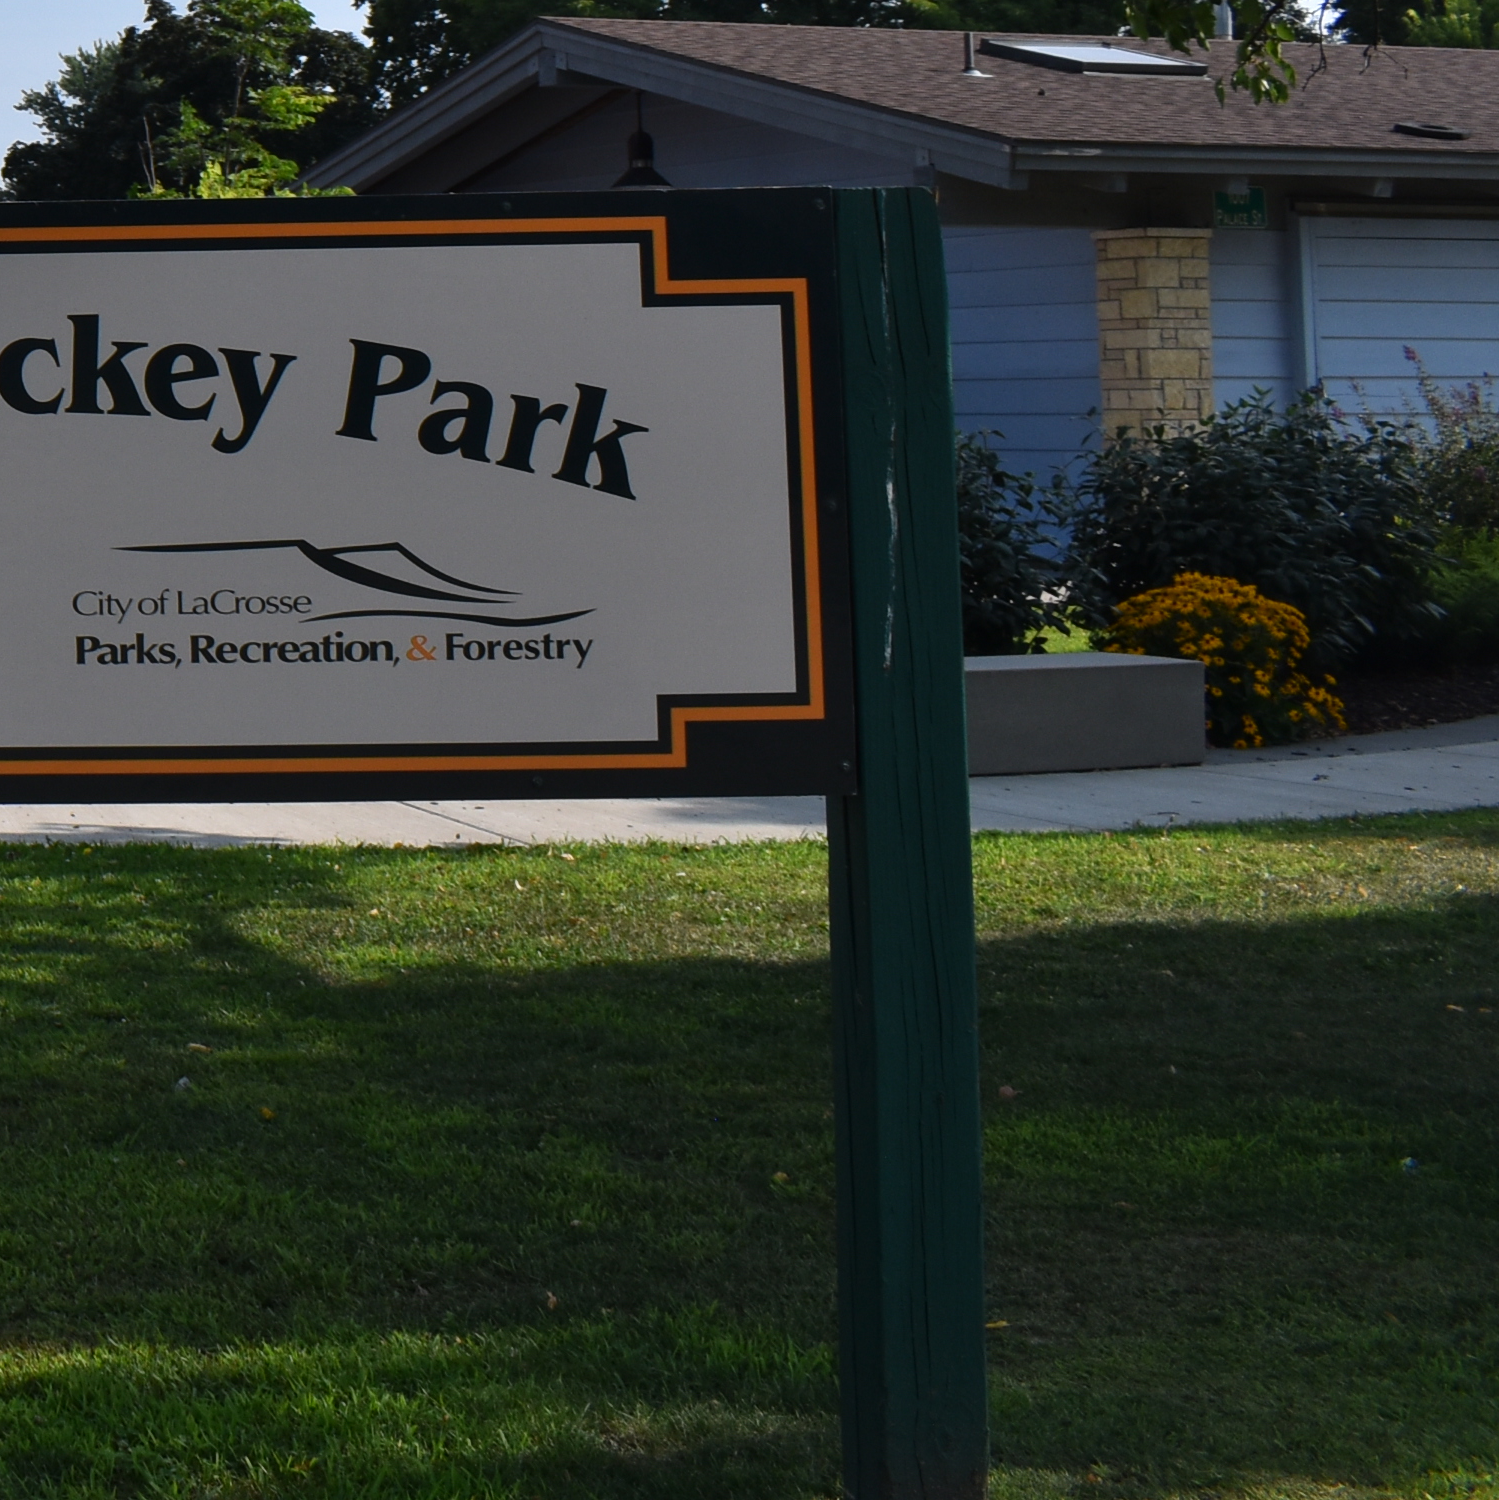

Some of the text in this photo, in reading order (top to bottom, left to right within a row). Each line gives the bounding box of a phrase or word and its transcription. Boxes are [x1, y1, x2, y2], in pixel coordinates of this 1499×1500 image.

[334, 338, 650, 501] Park
[71, 588, 313, 625] City of LaCrosse
[75, 630, 594, 670] Parks, Recreation, & Forestry
